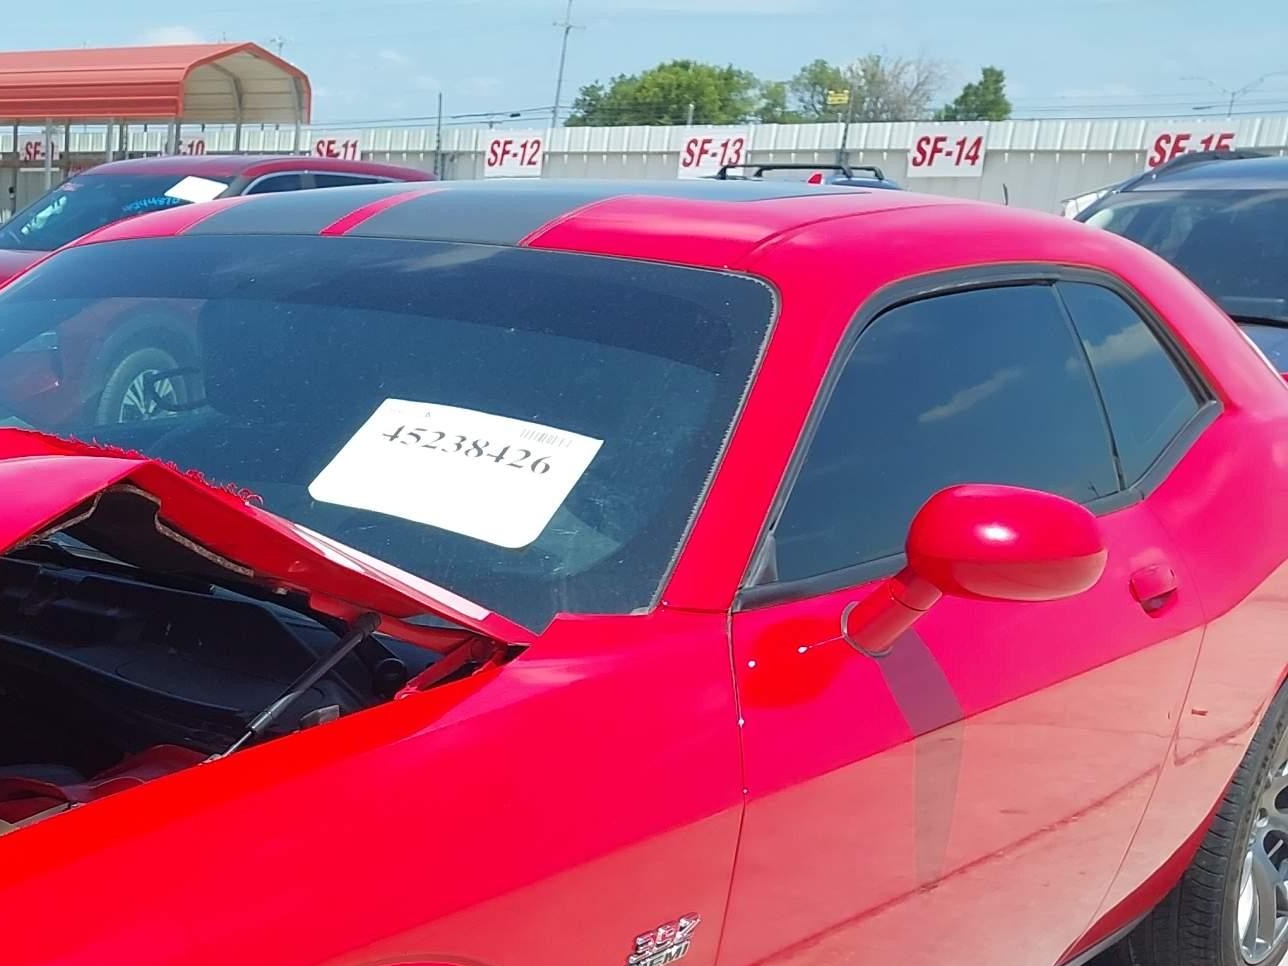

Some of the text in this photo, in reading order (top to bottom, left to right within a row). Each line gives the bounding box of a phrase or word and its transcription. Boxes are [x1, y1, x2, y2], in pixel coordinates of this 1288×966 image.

[315, 139, 360, 160] SF-11
[487, 139, 541, 167] SF-12
[682, 138, 744, 167] SF-13
[912, 135, 983, 167] SF-14
[382, 424, 552, 476] 45238426
